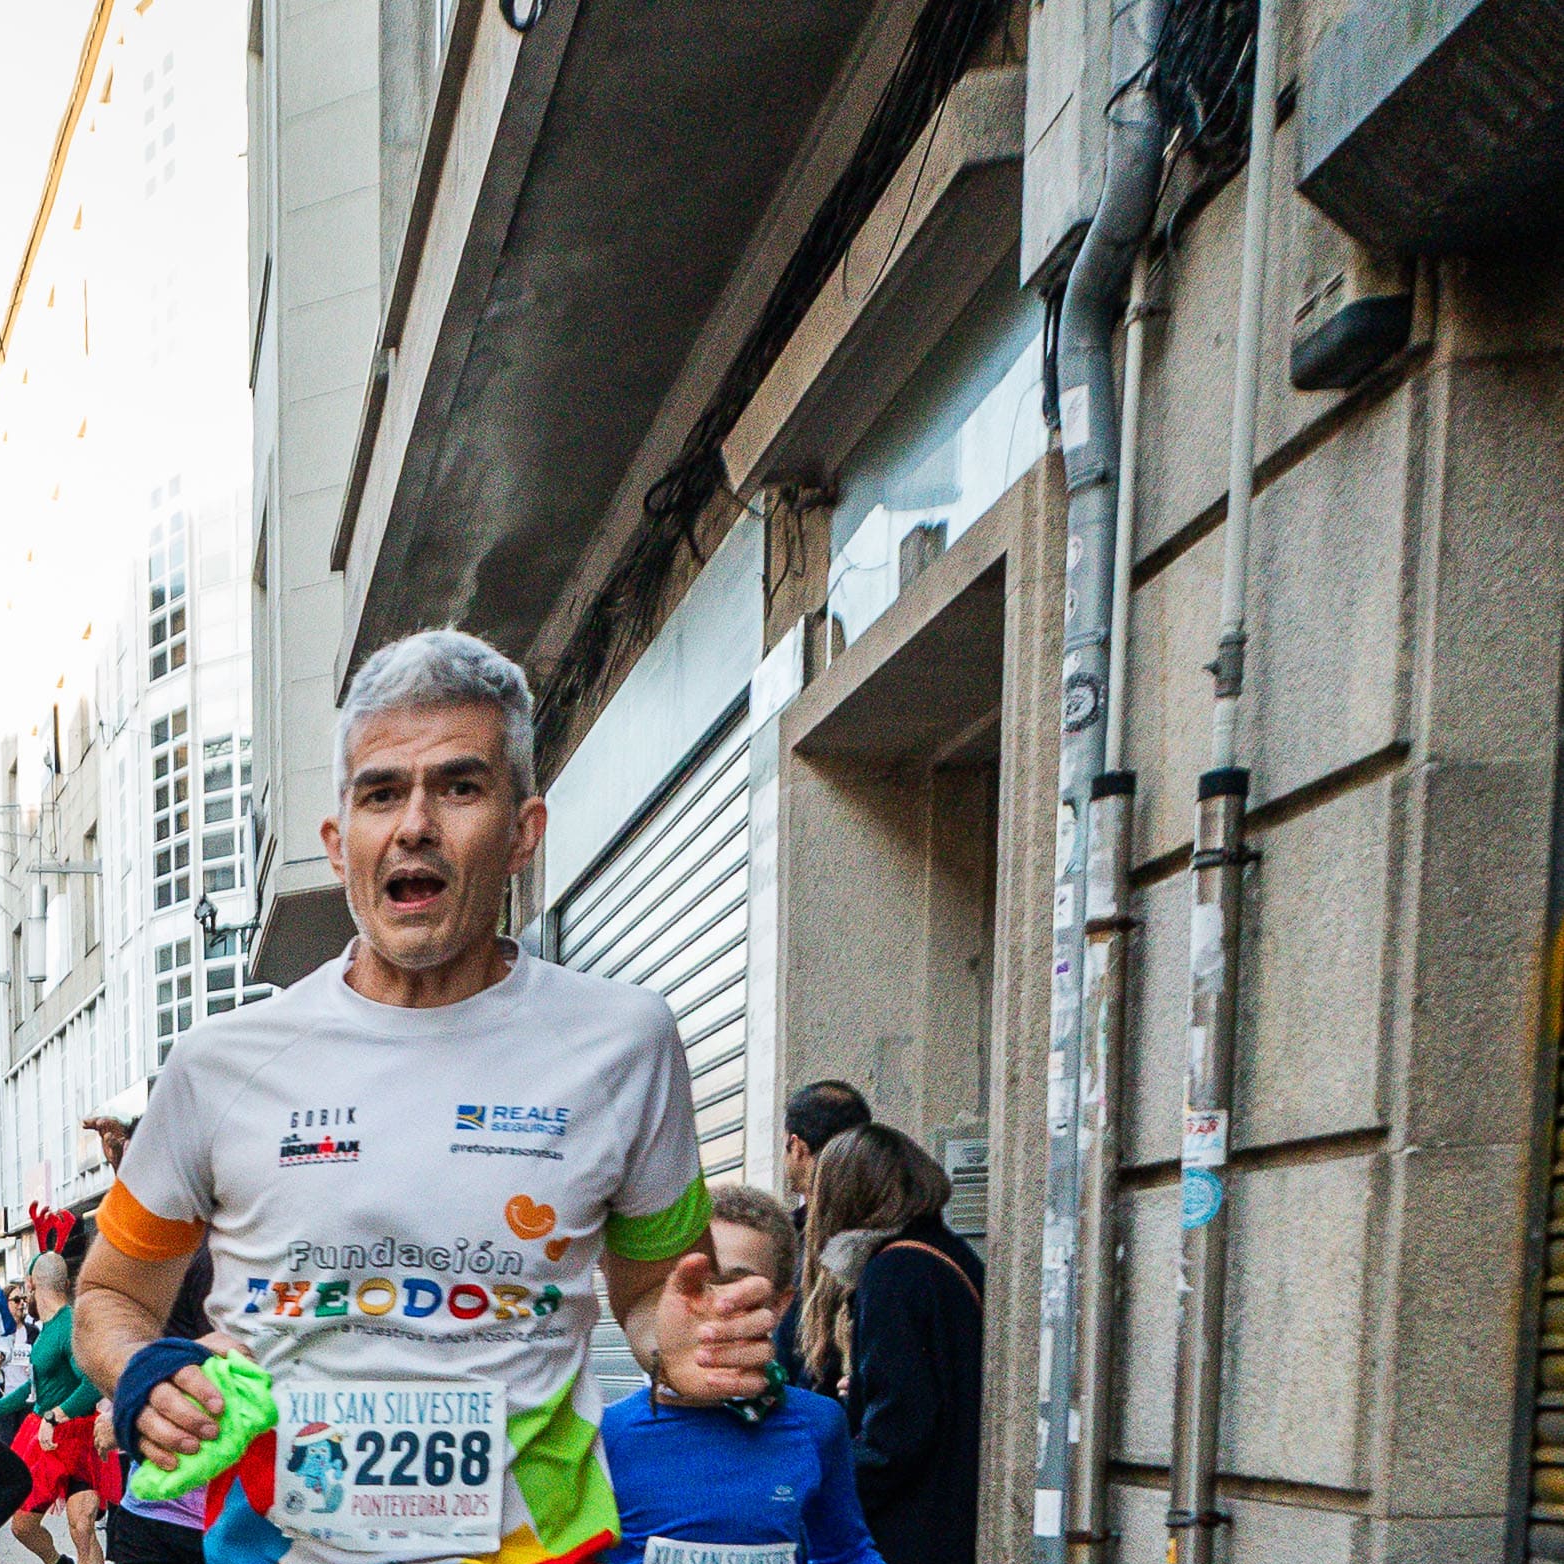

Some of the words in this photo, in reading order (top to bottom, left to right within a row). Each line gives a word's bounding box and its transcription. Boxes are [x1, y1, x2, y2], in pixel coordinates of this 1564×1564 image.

[290, 1106, 357, 1129] GOBIK
[491, 1122, 567, 1137] SEGUROS
[492, 1106, 570, 1123] REALE
[287, 1236, 524, 1275] Fundación
[244, 1277, 563, 1320] THEODORA
[332, 1391, 377, 1425] SAN
[383, 1391, 494, 1425] SILVESTRE
[354, 1429, 492, 1487] 2268
[350, 1493, 448, 1518] PONTEVEDRA
[451, 1492, 491, 1517] 2025
